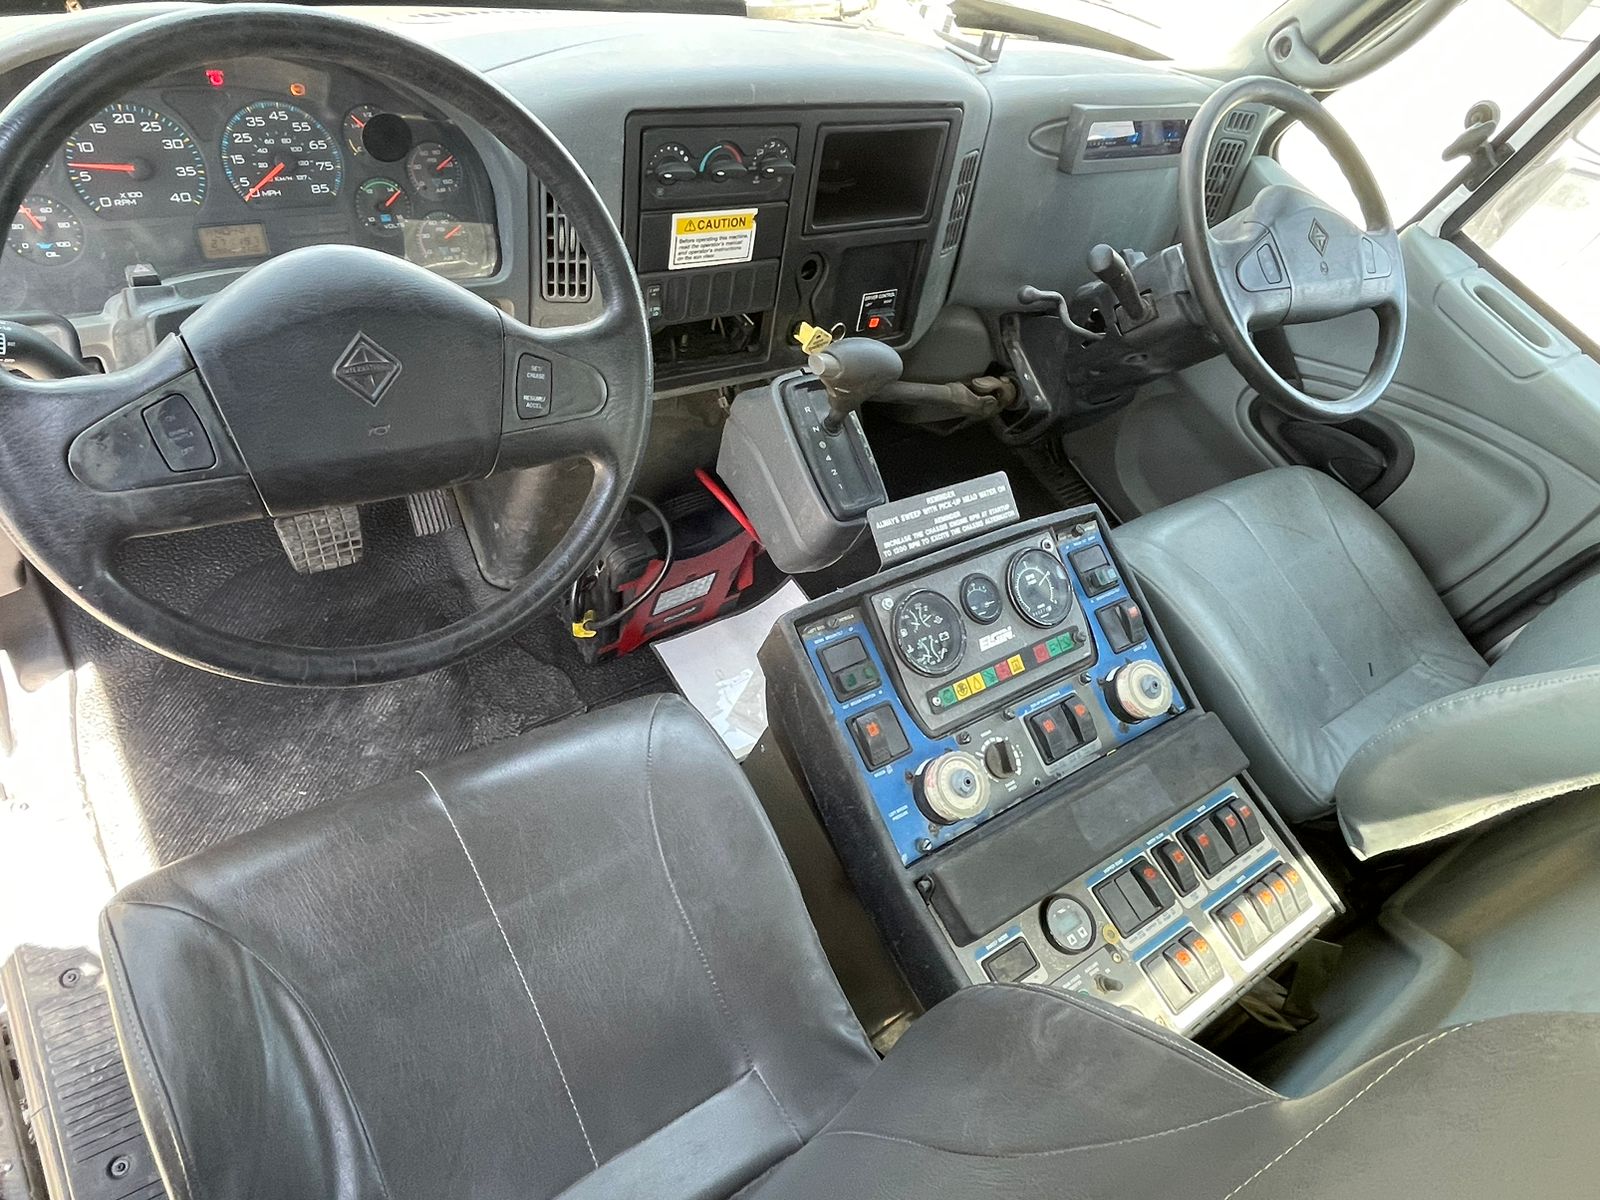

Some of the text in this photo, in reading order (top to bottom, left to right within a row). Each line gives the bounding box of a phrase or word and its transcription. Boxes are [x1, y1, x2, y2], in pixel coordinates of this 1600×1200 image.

[112, 113, 135, 124] 20
[268, 111, 289, 121] 45
[140, 121, 162, 133] 25
[246, 117, 266, 127] 35
[292, 122, 312, 132] 55
[89, 122, 107, 134] 15
[232, 133, 253, 144] 25
[76, 141, 95, 153] 10
[162, 139, 185, 150] 30
[308, 140, 328, 150] 65
[230, 154, 245, 165] 15
[175, 166, 197, 177] 35
[315, 161, 335, 171] 75
[79, 171, 92, 182] 5
[239, 177, 250, 187] 5
[249, 188, 282, 198] 0 MPH
[311, 184, 330, 194] 85
[99, 197, 137, 208] 0 RPM
[169, 192, 192, 203] 40
[39, 206, 53, 214] 60
[697, 217, 747, 230] CAUTION
[700, 241, 725, 249] operator's
[526, 372, 546, 380] CRUISE
[812, 425, 820, 433] N
[830, 468, 838, 476] 2
[926, 491, 956, 505] REMINDER
[876, 517, 900, 529] ALWAYS
[901, 510, 922, 522] SWEEP
[923, 506, 938, 515] WITH
[939, 499, 962, 510] PICK-UP
[962, 494, 978, 503] HEAD
[979, 488, 997, 498] WATER
[934, 512, 961, 524] REMINDER
[884, 536, 912, 548] INCREASE
[925, 525, 948, 536] CHASSIS
[989, 505, 1010, 515] STARTUP
[931, 533, 950, 542] EXCITE
[962, 522, 984, 532] CHASSIS
[985, 511, 1015, 524] ALTERNATOR
[978, 626, 1013, 652] ELGIN
